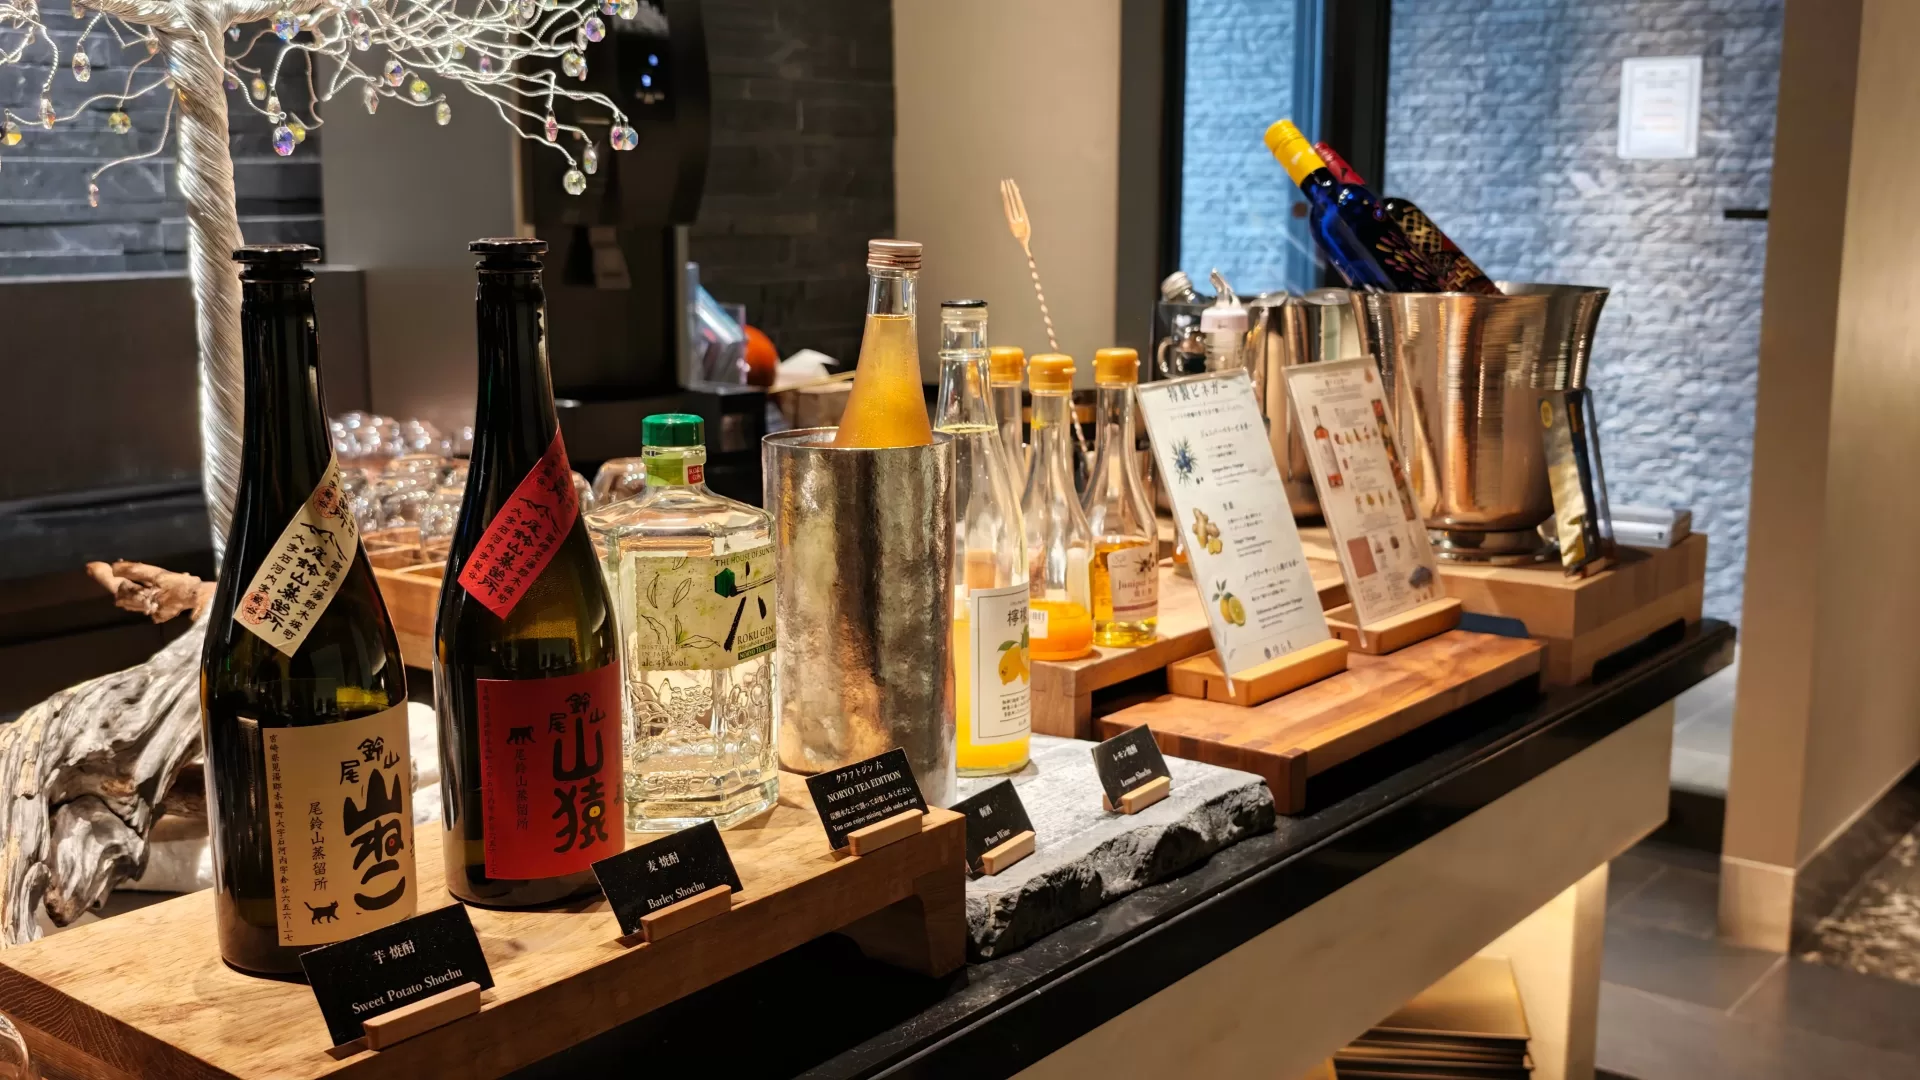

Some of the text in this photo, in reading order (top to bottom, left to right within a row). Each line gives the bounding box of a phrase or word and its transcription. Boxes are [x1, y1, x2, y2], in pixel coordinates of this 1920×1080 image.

[715, 557, 730, 567] THE
[731, 552, 750, 564] HOUSE
[737, 624, 774, 645] ROKU GIN
[826, 770, 902, 803] NORYO TEA EDITION
[836, 764, 873, 783] クラフトジン
[832, 824, 844, 832] You
[853, 816, 866, 825] enjoy
[865, 810, 883, 820] mixing
[882, 805, 893, 814] with
[892, 801, 904, 809] soda
[909, 796, 918, 804] any
[307, 801, 329, 892] 尾鈴山蒸留所
[984, 828, 1011, 847] Plum Wine
[658, 851, 680, 868] 焼酎
[647, 880, 706, 910] Barley Shochu
[372, 939, 416, 965] 芋 焼酎
[351, 967, 463, 1015] Sweet Potato Shochu
